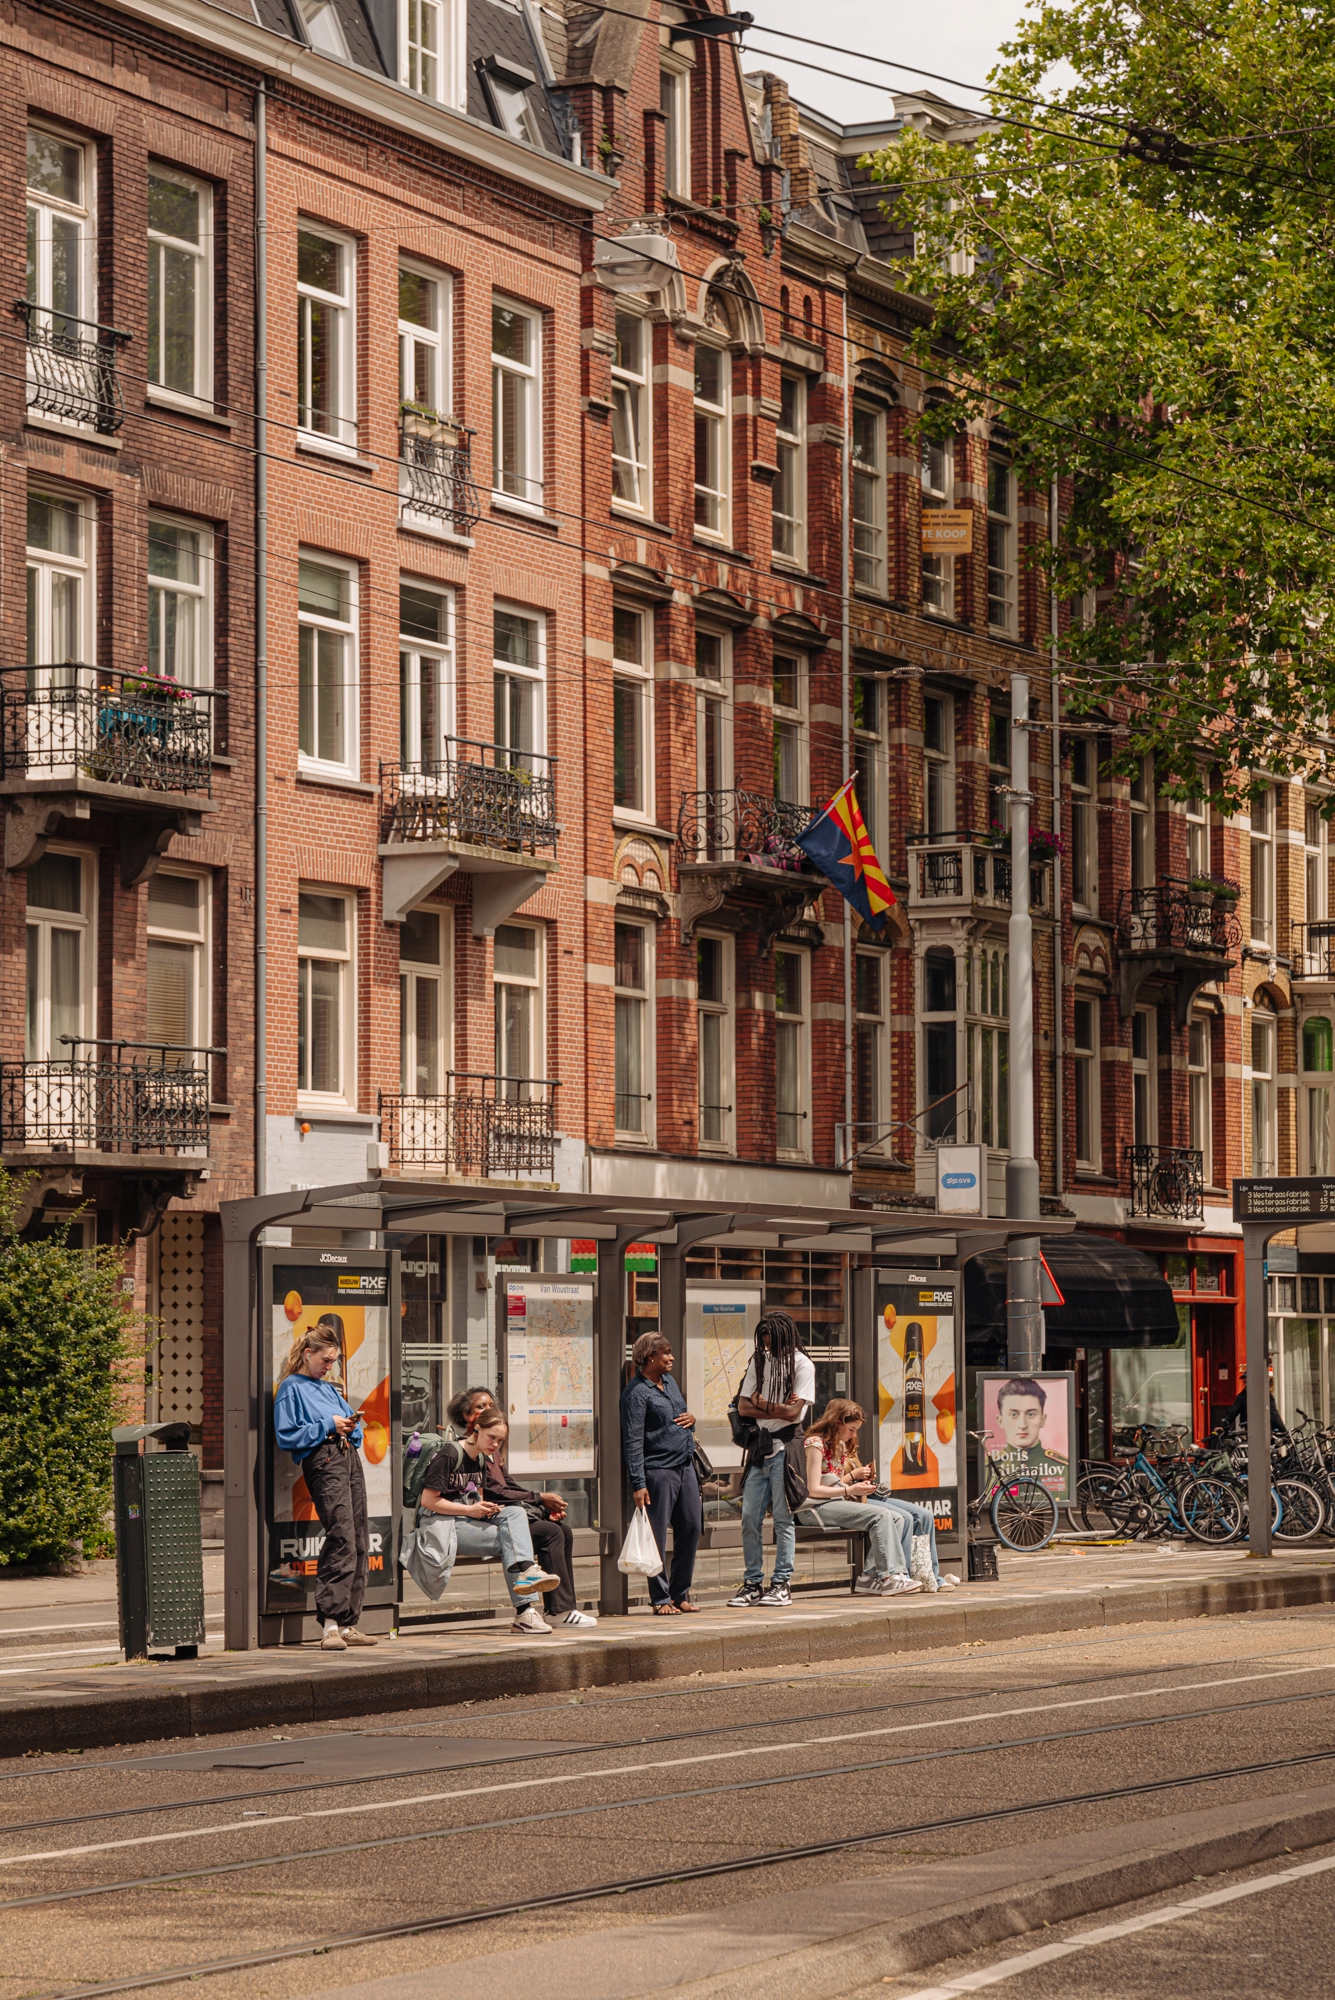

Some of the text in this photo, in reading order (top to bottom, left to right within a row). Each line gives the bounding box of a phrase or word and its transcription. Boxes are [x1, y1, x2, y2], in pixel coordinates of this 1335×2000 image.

[922, 530, 967, 538] TE KOOP
[1253, 1191, 1310, 1199] Westergasfabriek
[1253, 1198, 1310, 1206] Westergasfabriek
[1253, 1205, 1310, 1213] Westergasfabriek
[320, 1253, 348, 1263] JCDecaux
[360, 1276, 387, 1288] AXE
[540, 1284, 579, 1294] Van Woustraat
[934, 1292, 953, 1301] AXE
[905, 1381, 922, 1391] AXE
[991, 1448, 1028, 1462] Boris
